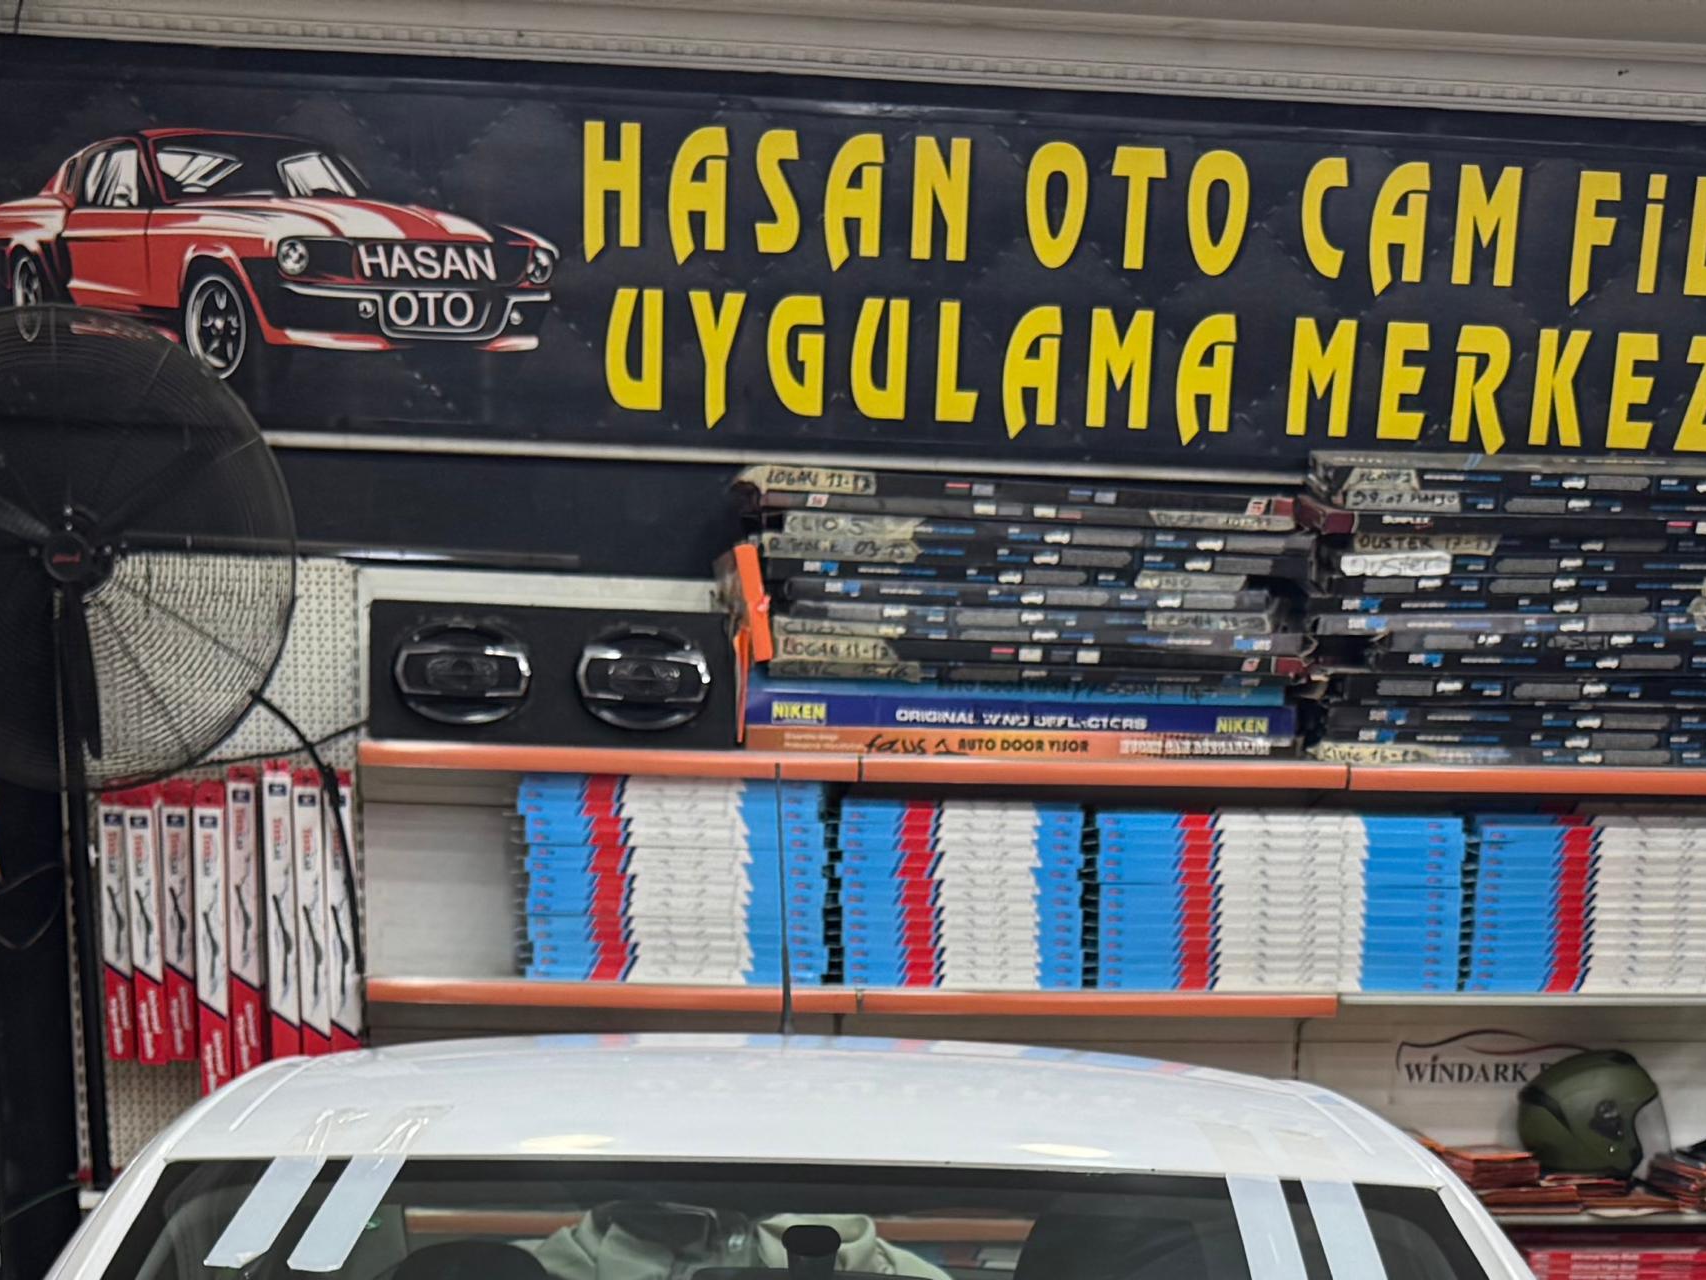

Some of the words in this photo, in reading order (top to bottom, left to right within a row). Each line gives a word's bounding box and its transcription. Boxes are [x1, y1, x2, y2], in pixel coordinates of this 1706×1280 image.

[584, 121, 973, 272] HASAN
[1026, 142, 1250, 277] OTO
[1302, 157, 1523, 296] CAM
[358, 244, 497, 282] HASAN
[387, 291, 476, 327] OTO
[605, 287, 1238, 445] UYGULAMA
[772, 703, 825, 719] NIKEN
[895, 709, 976, 725] ORIGINAL
[1216, 717, 1269, 734] NIKEN
[958, 737, 997, 751] AUTO
[1000, 739, 1045, 753] DOOR
